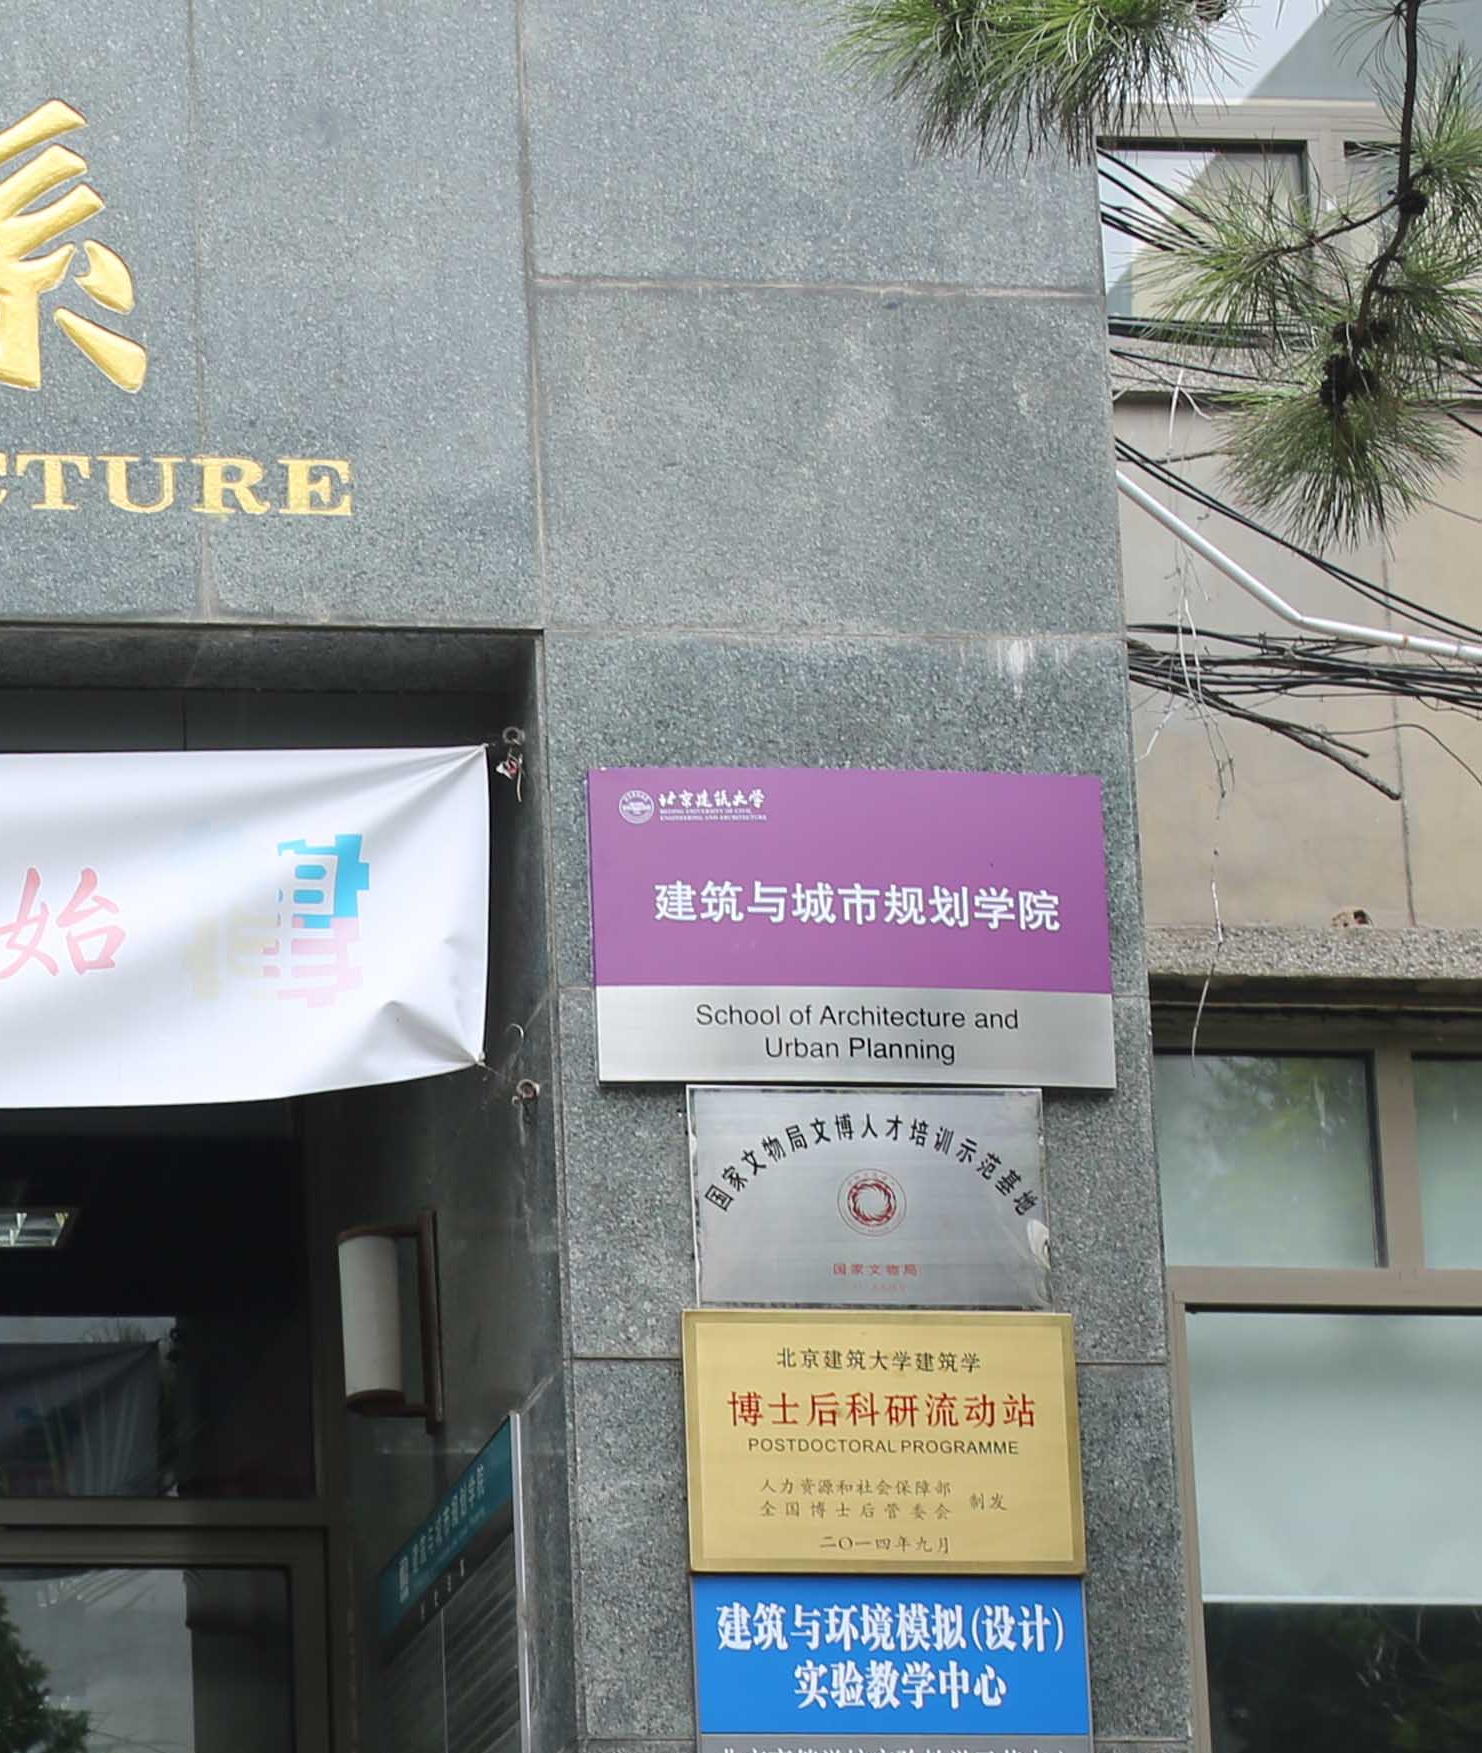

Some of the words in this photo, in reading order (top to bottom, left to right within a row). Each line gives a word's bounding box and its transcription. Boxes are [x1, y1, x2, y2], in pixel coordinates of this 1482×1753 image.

[653, 879, 1061, 932] 建筑与城市规划学院
[696, 1003, 781, 1027] School
[788, 1003, 812, 1027] of
[819, 1005, 966, 1030] Architecture
[974, 1008, 1020, 1031] and
[763, 1037, 840, 1060] Urban
[849, 1038, 956, 1065] Planning
[704, 1112, 1039, 1217] 国家文物局文博人才培训示范基地
[776, 1347, 982, 1373] 北京建筑大学建筑学
[727, 1390, 1037, 1429] 博士后科研流动站
[748, 1437, 897, 1455] POSTDOCTORAL
[901, 1439, 1020, 1456] PROGRAMME
[759, 1478, 953, 1498] 人力资源和社会保障部
[759, 1501, 953, 1520] 全国博士后管委会
[969, 1493, 1008, 1512] 制发
[794, 1660, 1008, 1710] 实验教学中心
